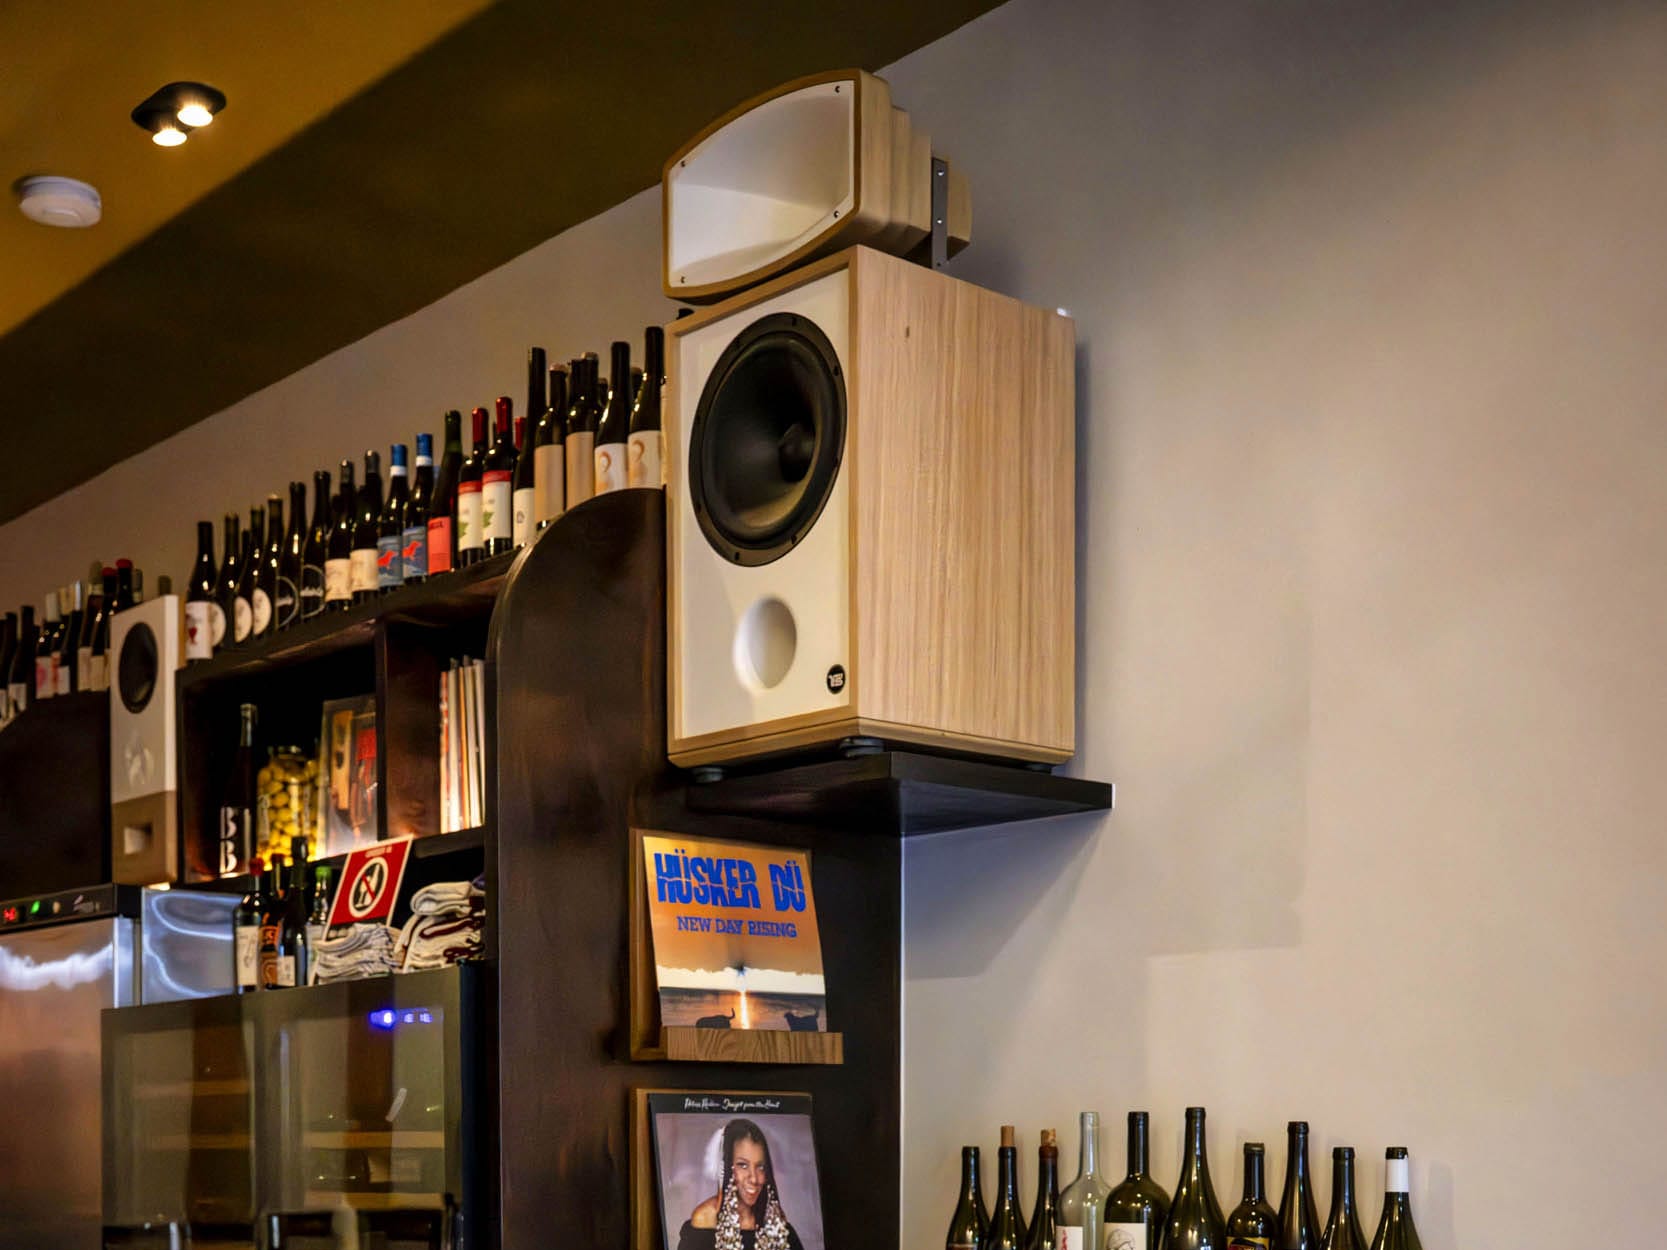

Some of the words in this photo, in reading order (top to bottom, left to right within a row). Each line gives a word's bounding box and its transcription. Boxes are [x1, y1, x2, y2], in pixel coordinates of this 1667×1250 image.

[653, 848, 761, 909] HÜSKER
[768, 860, 807, 912] DÜ
[676, 915, 712, 933] NEW
[715, 918, 743, 935] DAY
[747, 920, 798, 938] RISING
